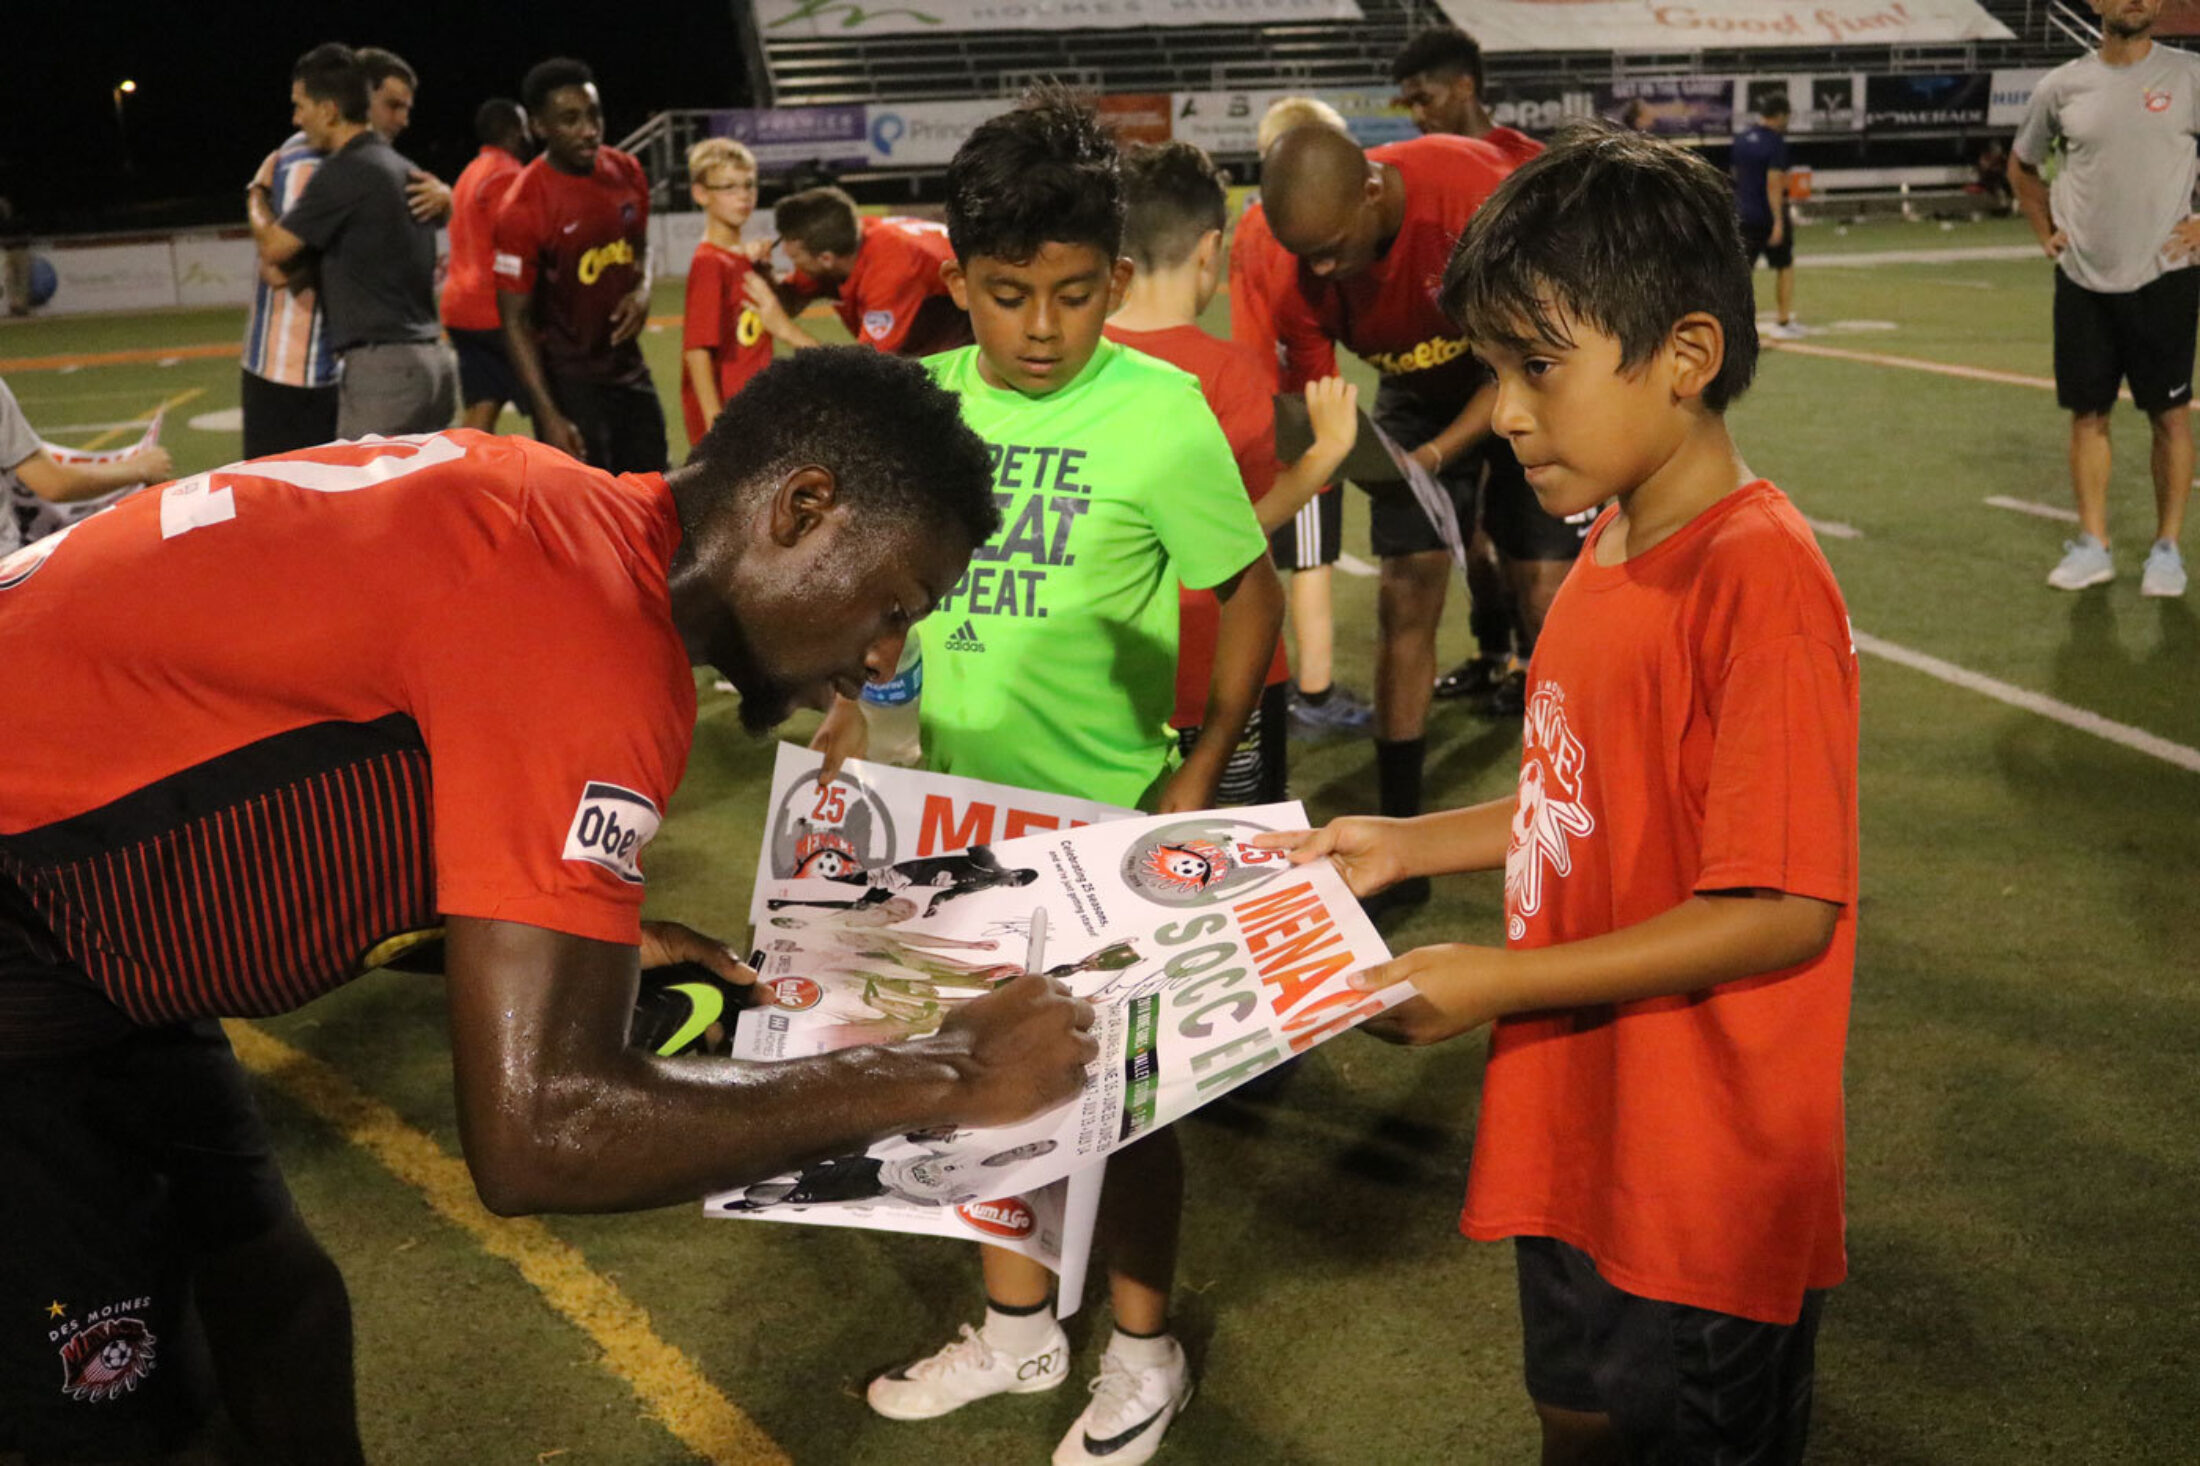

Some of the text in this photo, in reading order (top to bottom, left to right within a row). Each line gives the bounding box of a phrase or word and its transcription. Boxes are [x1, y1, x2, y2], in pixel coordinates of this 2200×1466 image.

[1652, 5, 1801, 36] Good
[944, 636, 987, 653] adidas
[811, 783, 847, 825] 25
[576, 805, 638, 860] Obe
[1060, 840, 1087, 883] Celebrating
[1081, 882, 1095, 893] 25
[963, 1200, 1000, 1220] Kum
[1010, 1208, 1031, 1229] Go
[48, 1319, 80, 1342] DES
[87, 1296, 152, 1324] MOINES
